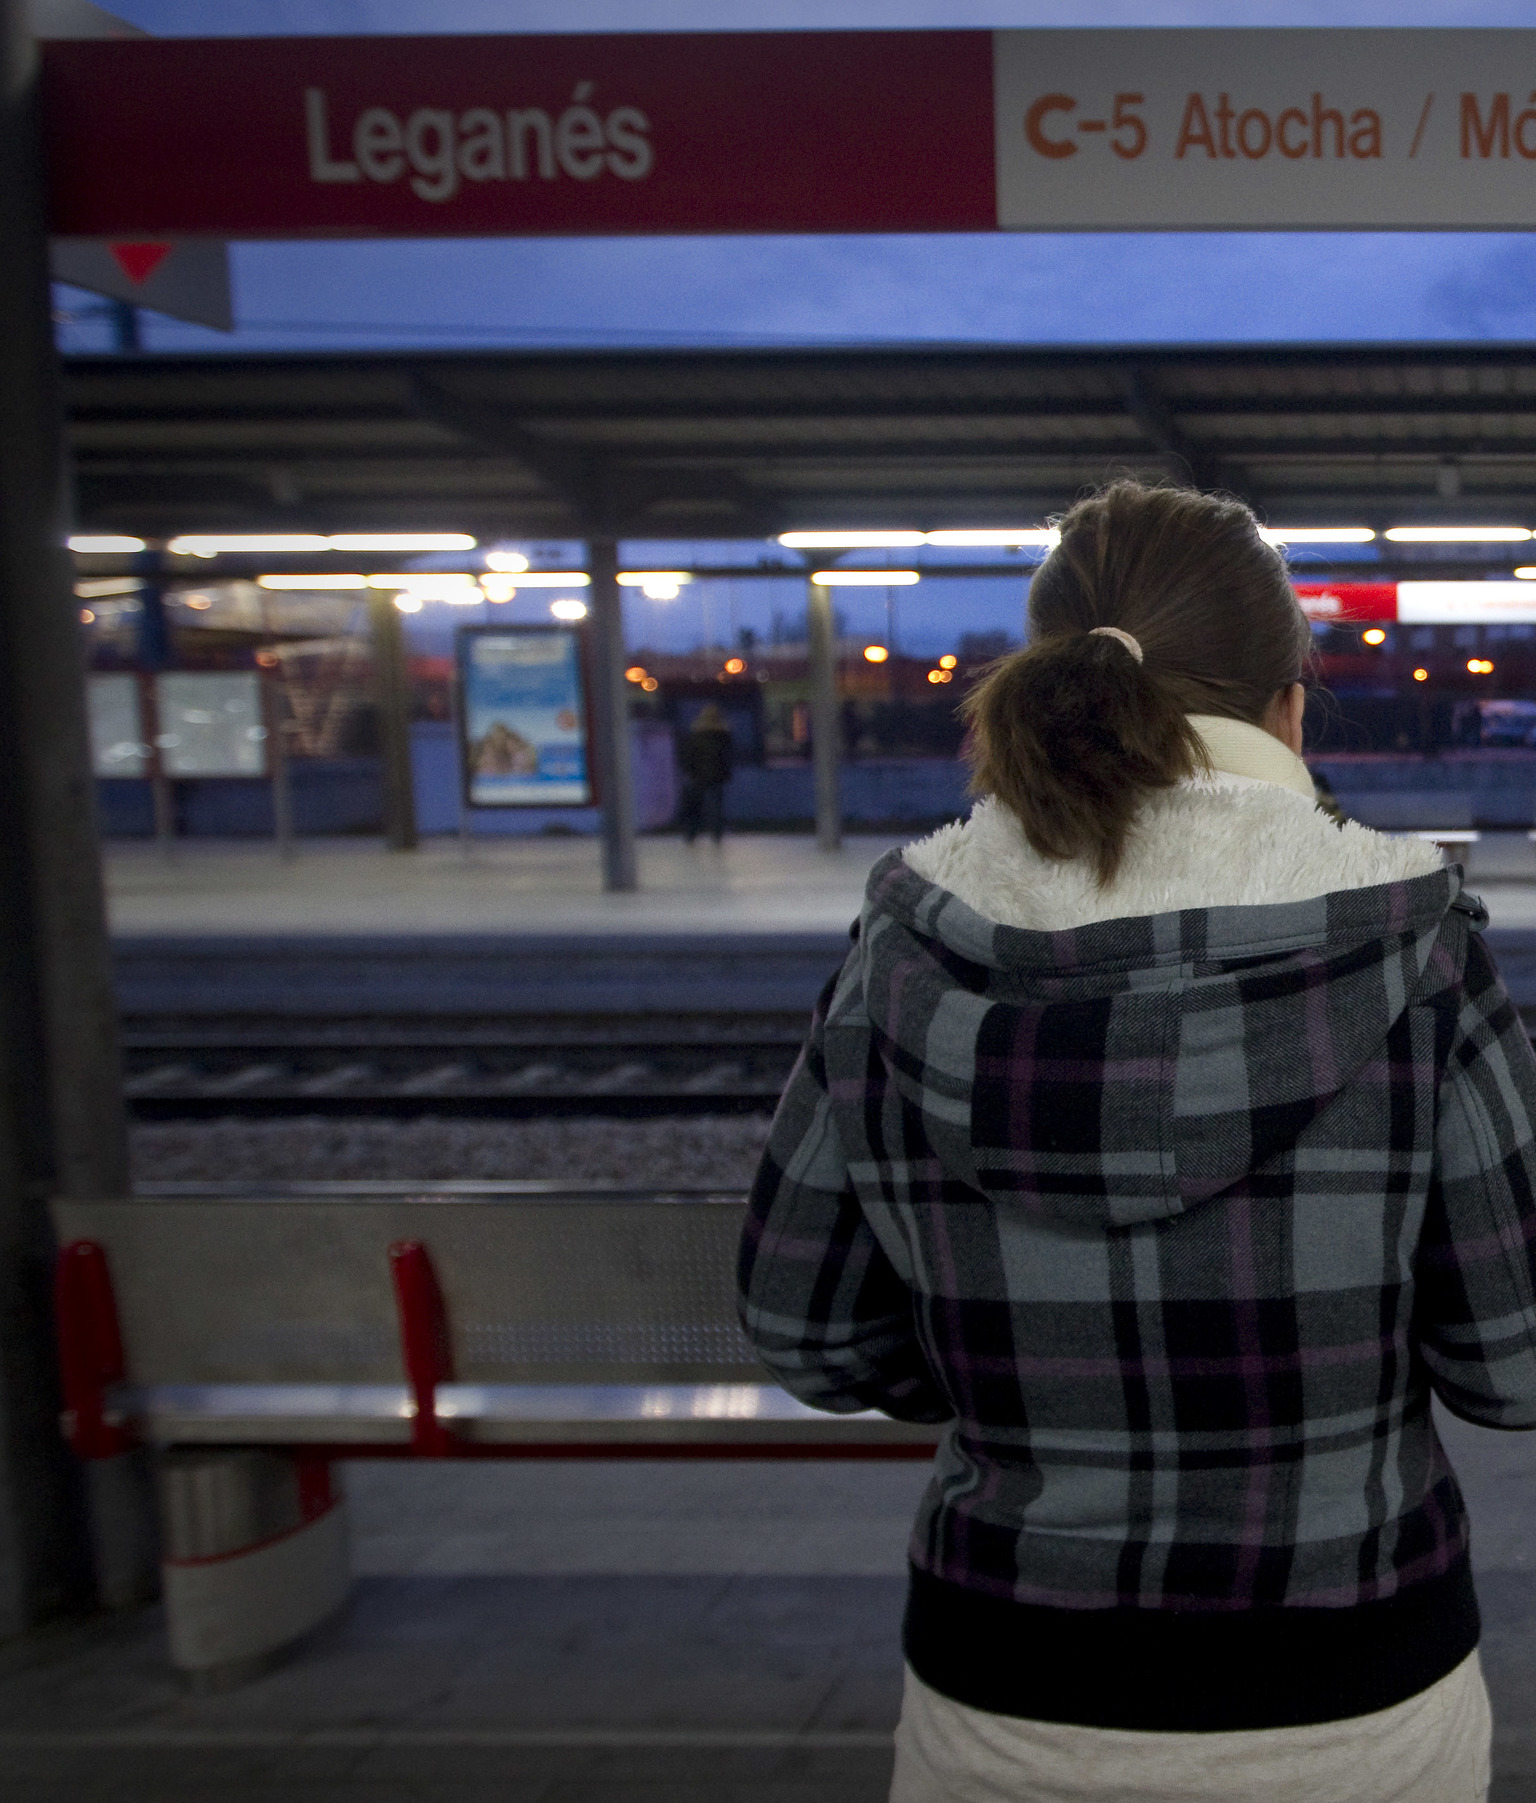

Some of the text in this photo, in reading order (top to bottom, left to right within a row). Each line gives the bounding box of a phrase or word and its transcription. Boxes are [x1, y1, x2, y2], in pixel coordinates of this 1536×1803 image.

[304, 79, 655, 202] Leganés
[1023, 92, 1148, 161] C-5
[1173, 92, 1384, 161] Atocha
